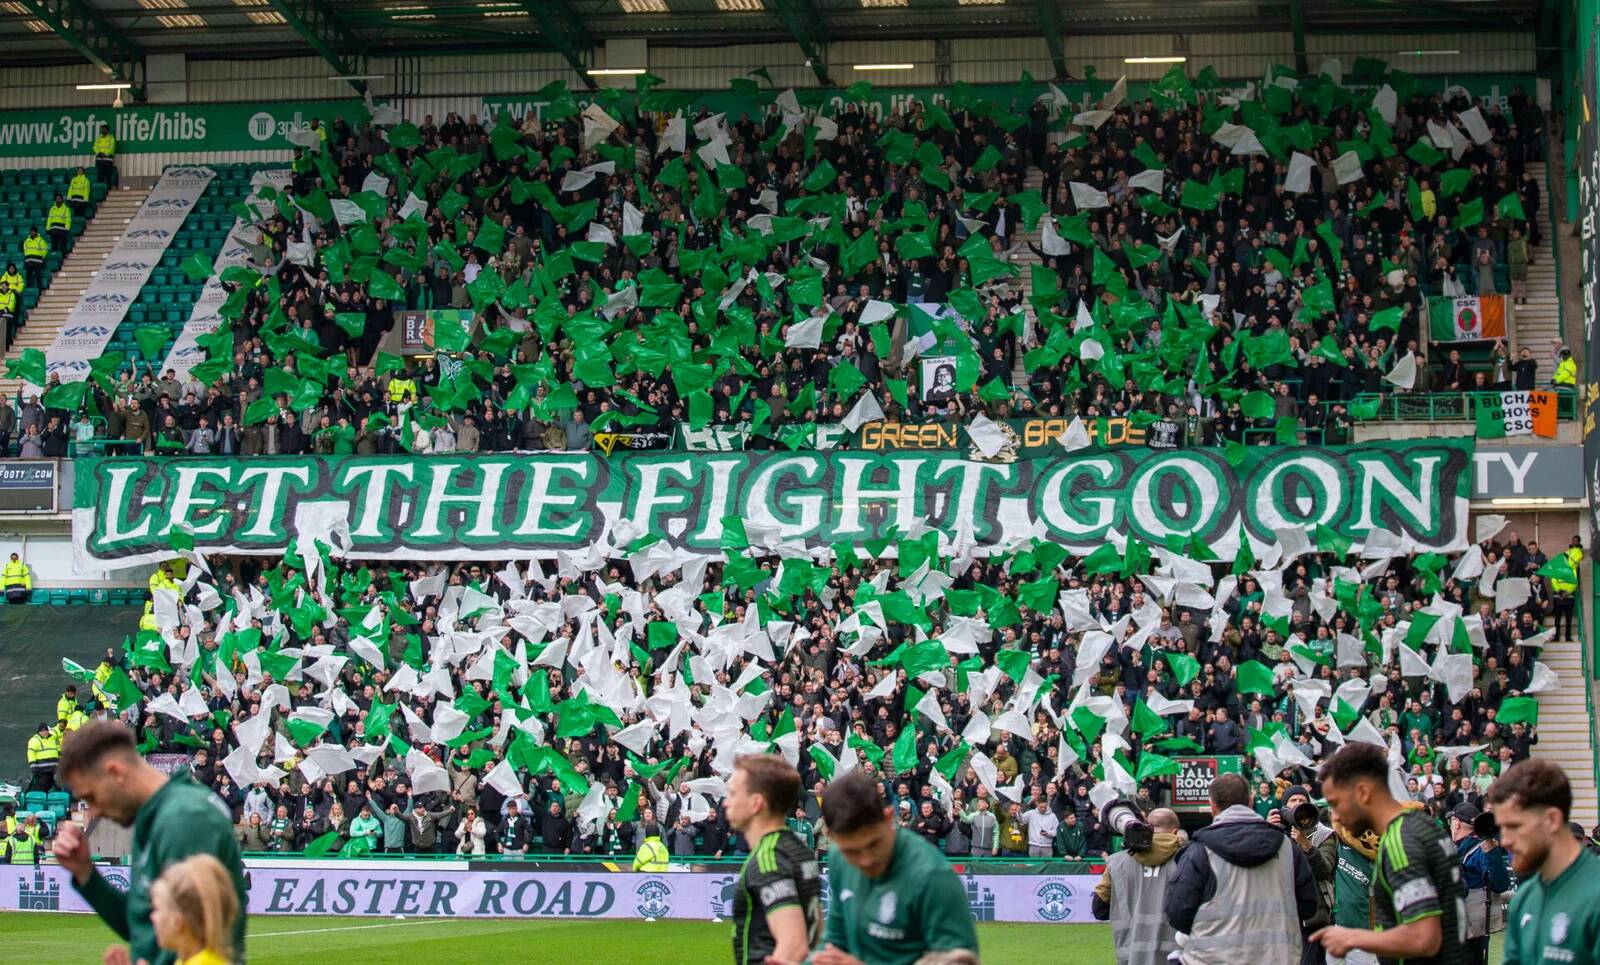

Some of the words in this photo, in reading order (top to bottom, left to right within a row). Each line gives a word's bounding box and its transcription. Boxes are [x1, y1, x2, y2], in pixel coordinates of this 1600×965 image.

[0, 111, 207, 150] www.3pflife/hibs
[1456, 299, 1477, 307] CSC
[1482, 394, 1548, 408] BUCHAN
[1491, 407, 1540, 420] BHOYS
[1503, 420, 1534, 432] CSC
[861, 421, 957, 450] GREEN
[1024, 418, 1146, 448] BRADE
[98, 464, 309, 546] LET
[340, 460, 589, 541] THE
[630, 456, 1012, 544] FIGHT
[1042, 456, 1220, 537] GO
[1256, 457, 1442, 532] ON
[1176, 788, 1200, 796] SPORTS
[264, 878, 459, 915] EASTER
[473, 879, 616, 917] ROAD
